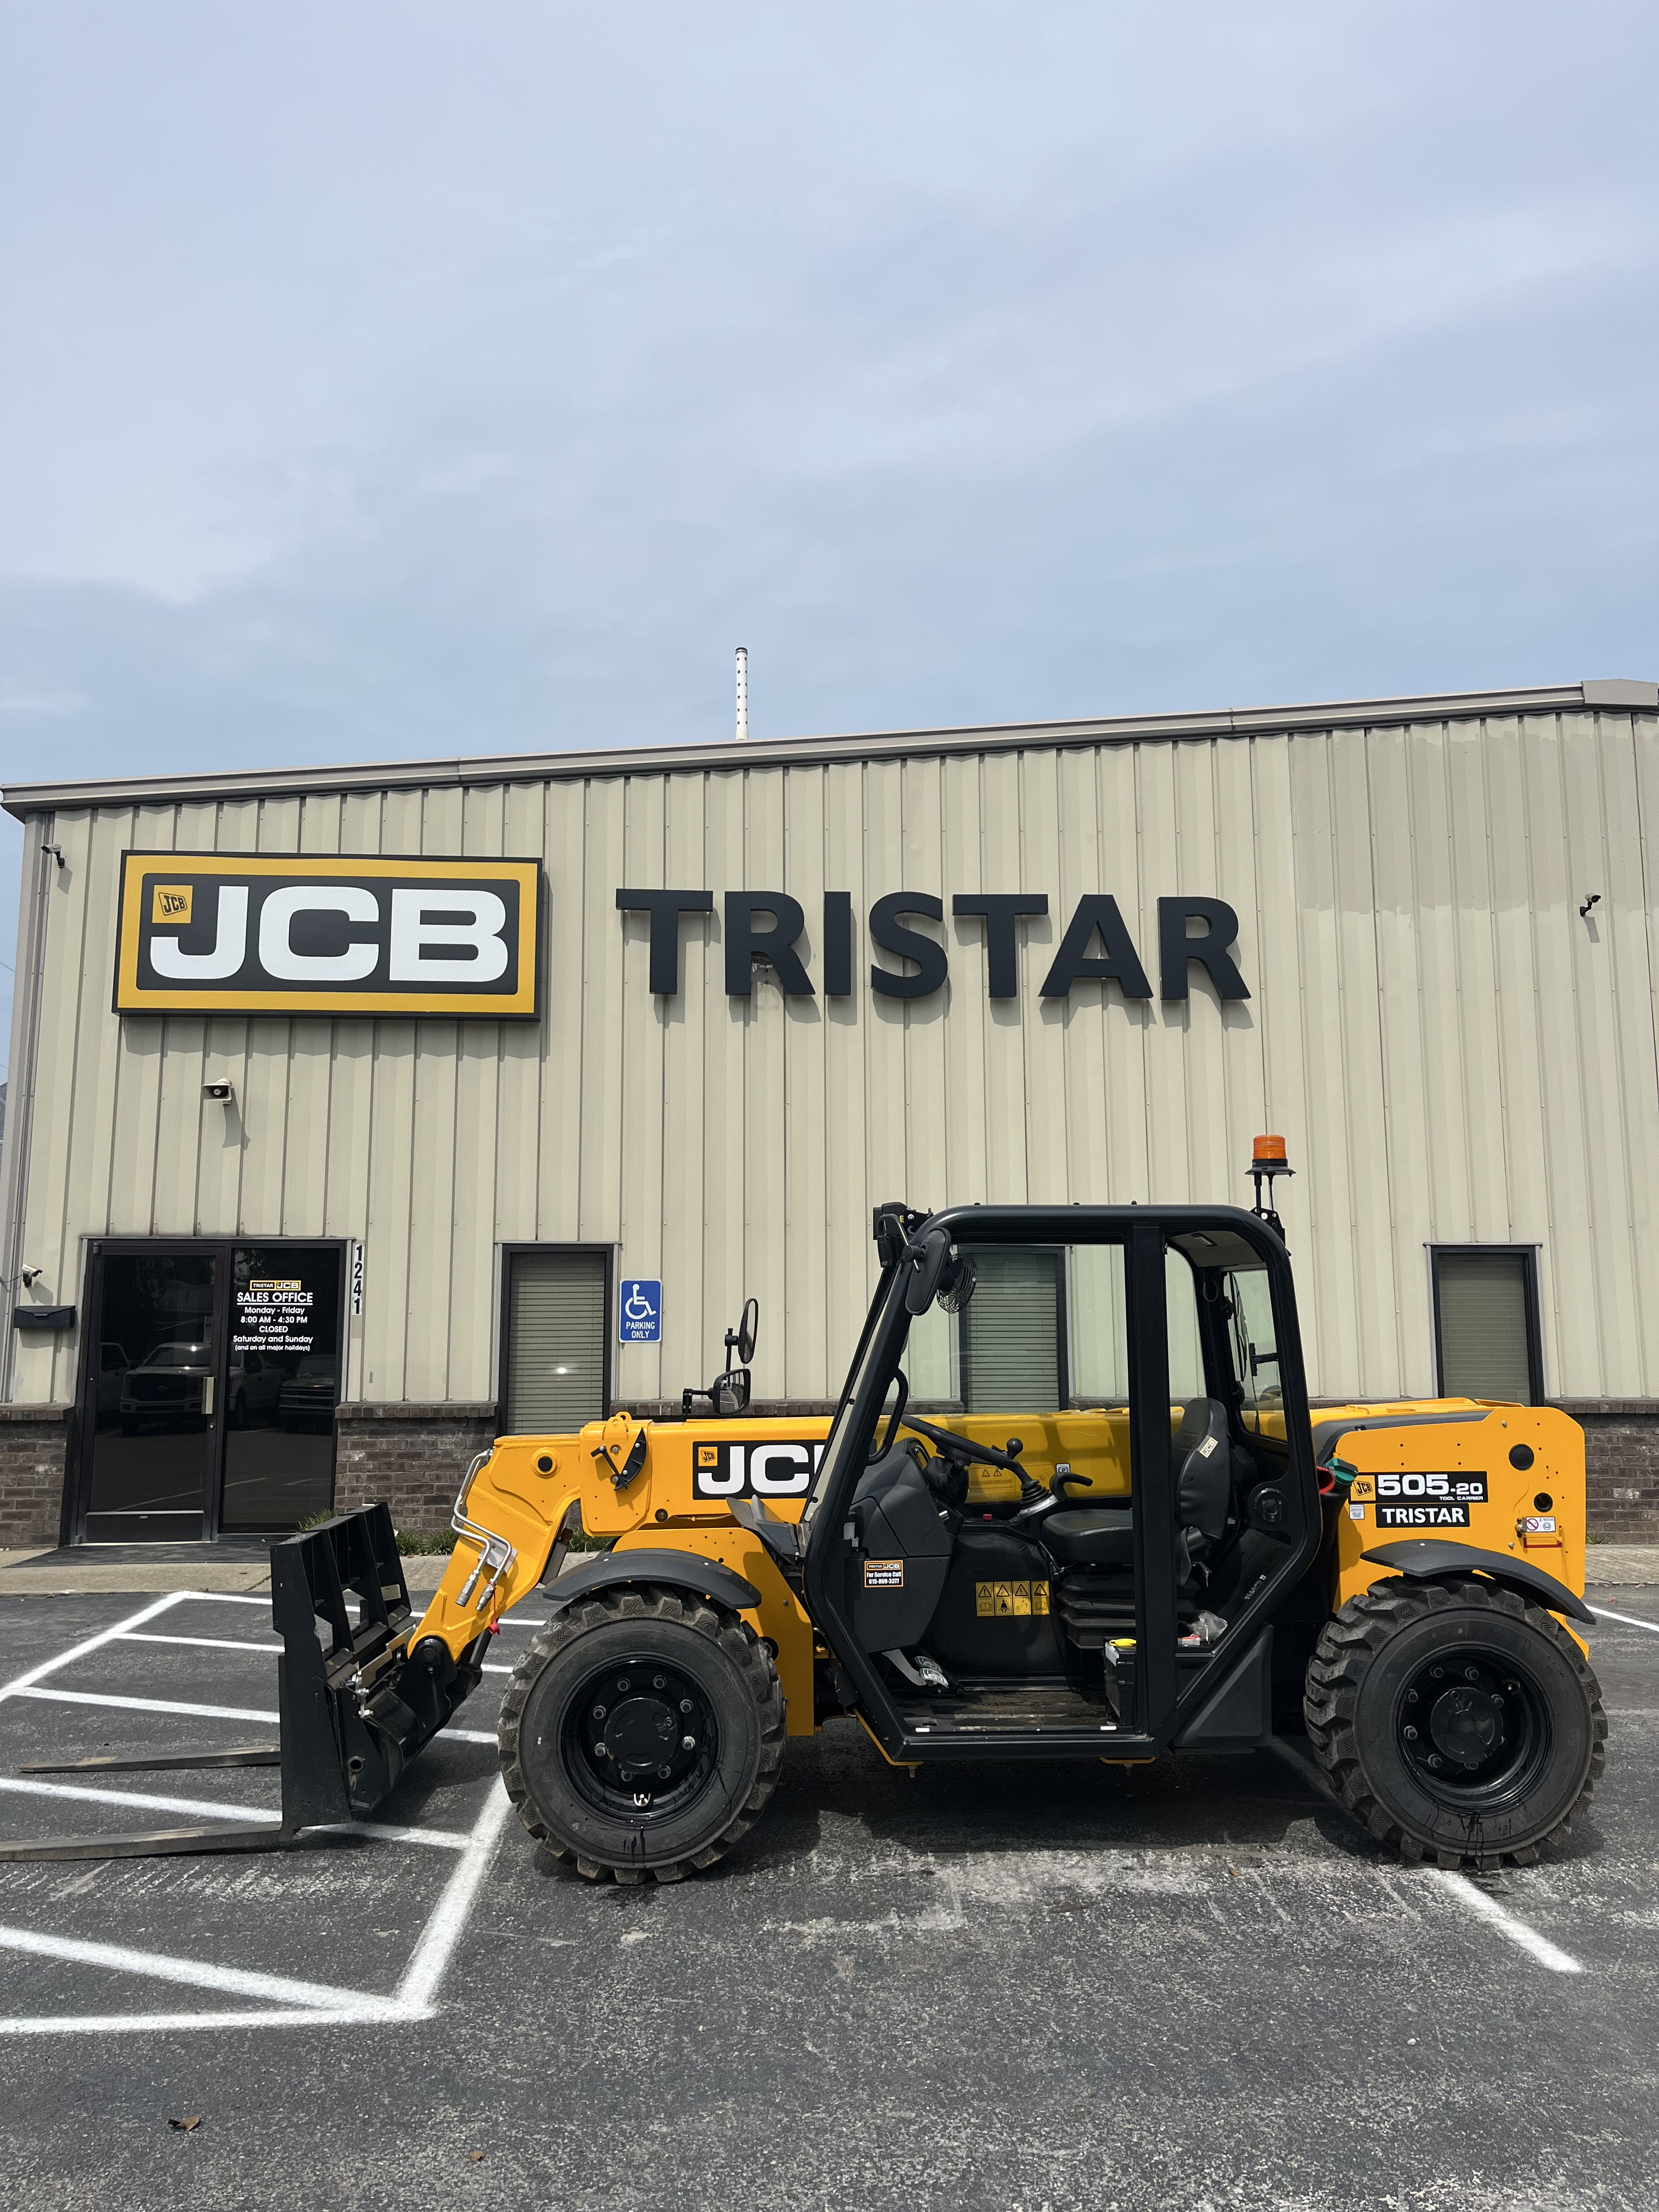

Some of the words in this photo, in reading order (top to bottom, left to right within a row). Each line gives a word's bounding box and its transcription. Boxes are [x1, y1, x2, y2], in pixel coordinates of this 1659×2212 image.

[163, 895, 185, 913] JCB
[150, 885, 508, 982] JCB
[616, 888, 1251, 1000] TRISTAR
[353, 1245, 363, 1314] 1241
[237, 1292, 269, 1302] SALES
[272, 1292, 313, 1302] OFFICE
[245, 1307, 275, 1315] Monday
[626, 1321, 655, 1330] PARKING
[233, 1335, 266, 1344] Saturday
[285, 1335, 313, 1344] Sunday
[631, 1330, 650, 1339] ONLY
[1203, 1440, 1216, 1455] JCB
[703, 1452, 715, 1462] JCB
[698, 1444, 826, 1494] JC
[1357, 1482, 1371, 1494] JCB
[1378, 1474, 1483, 1496] 505-20
[1382, 1508, 1465, 1523] TRISTAR
